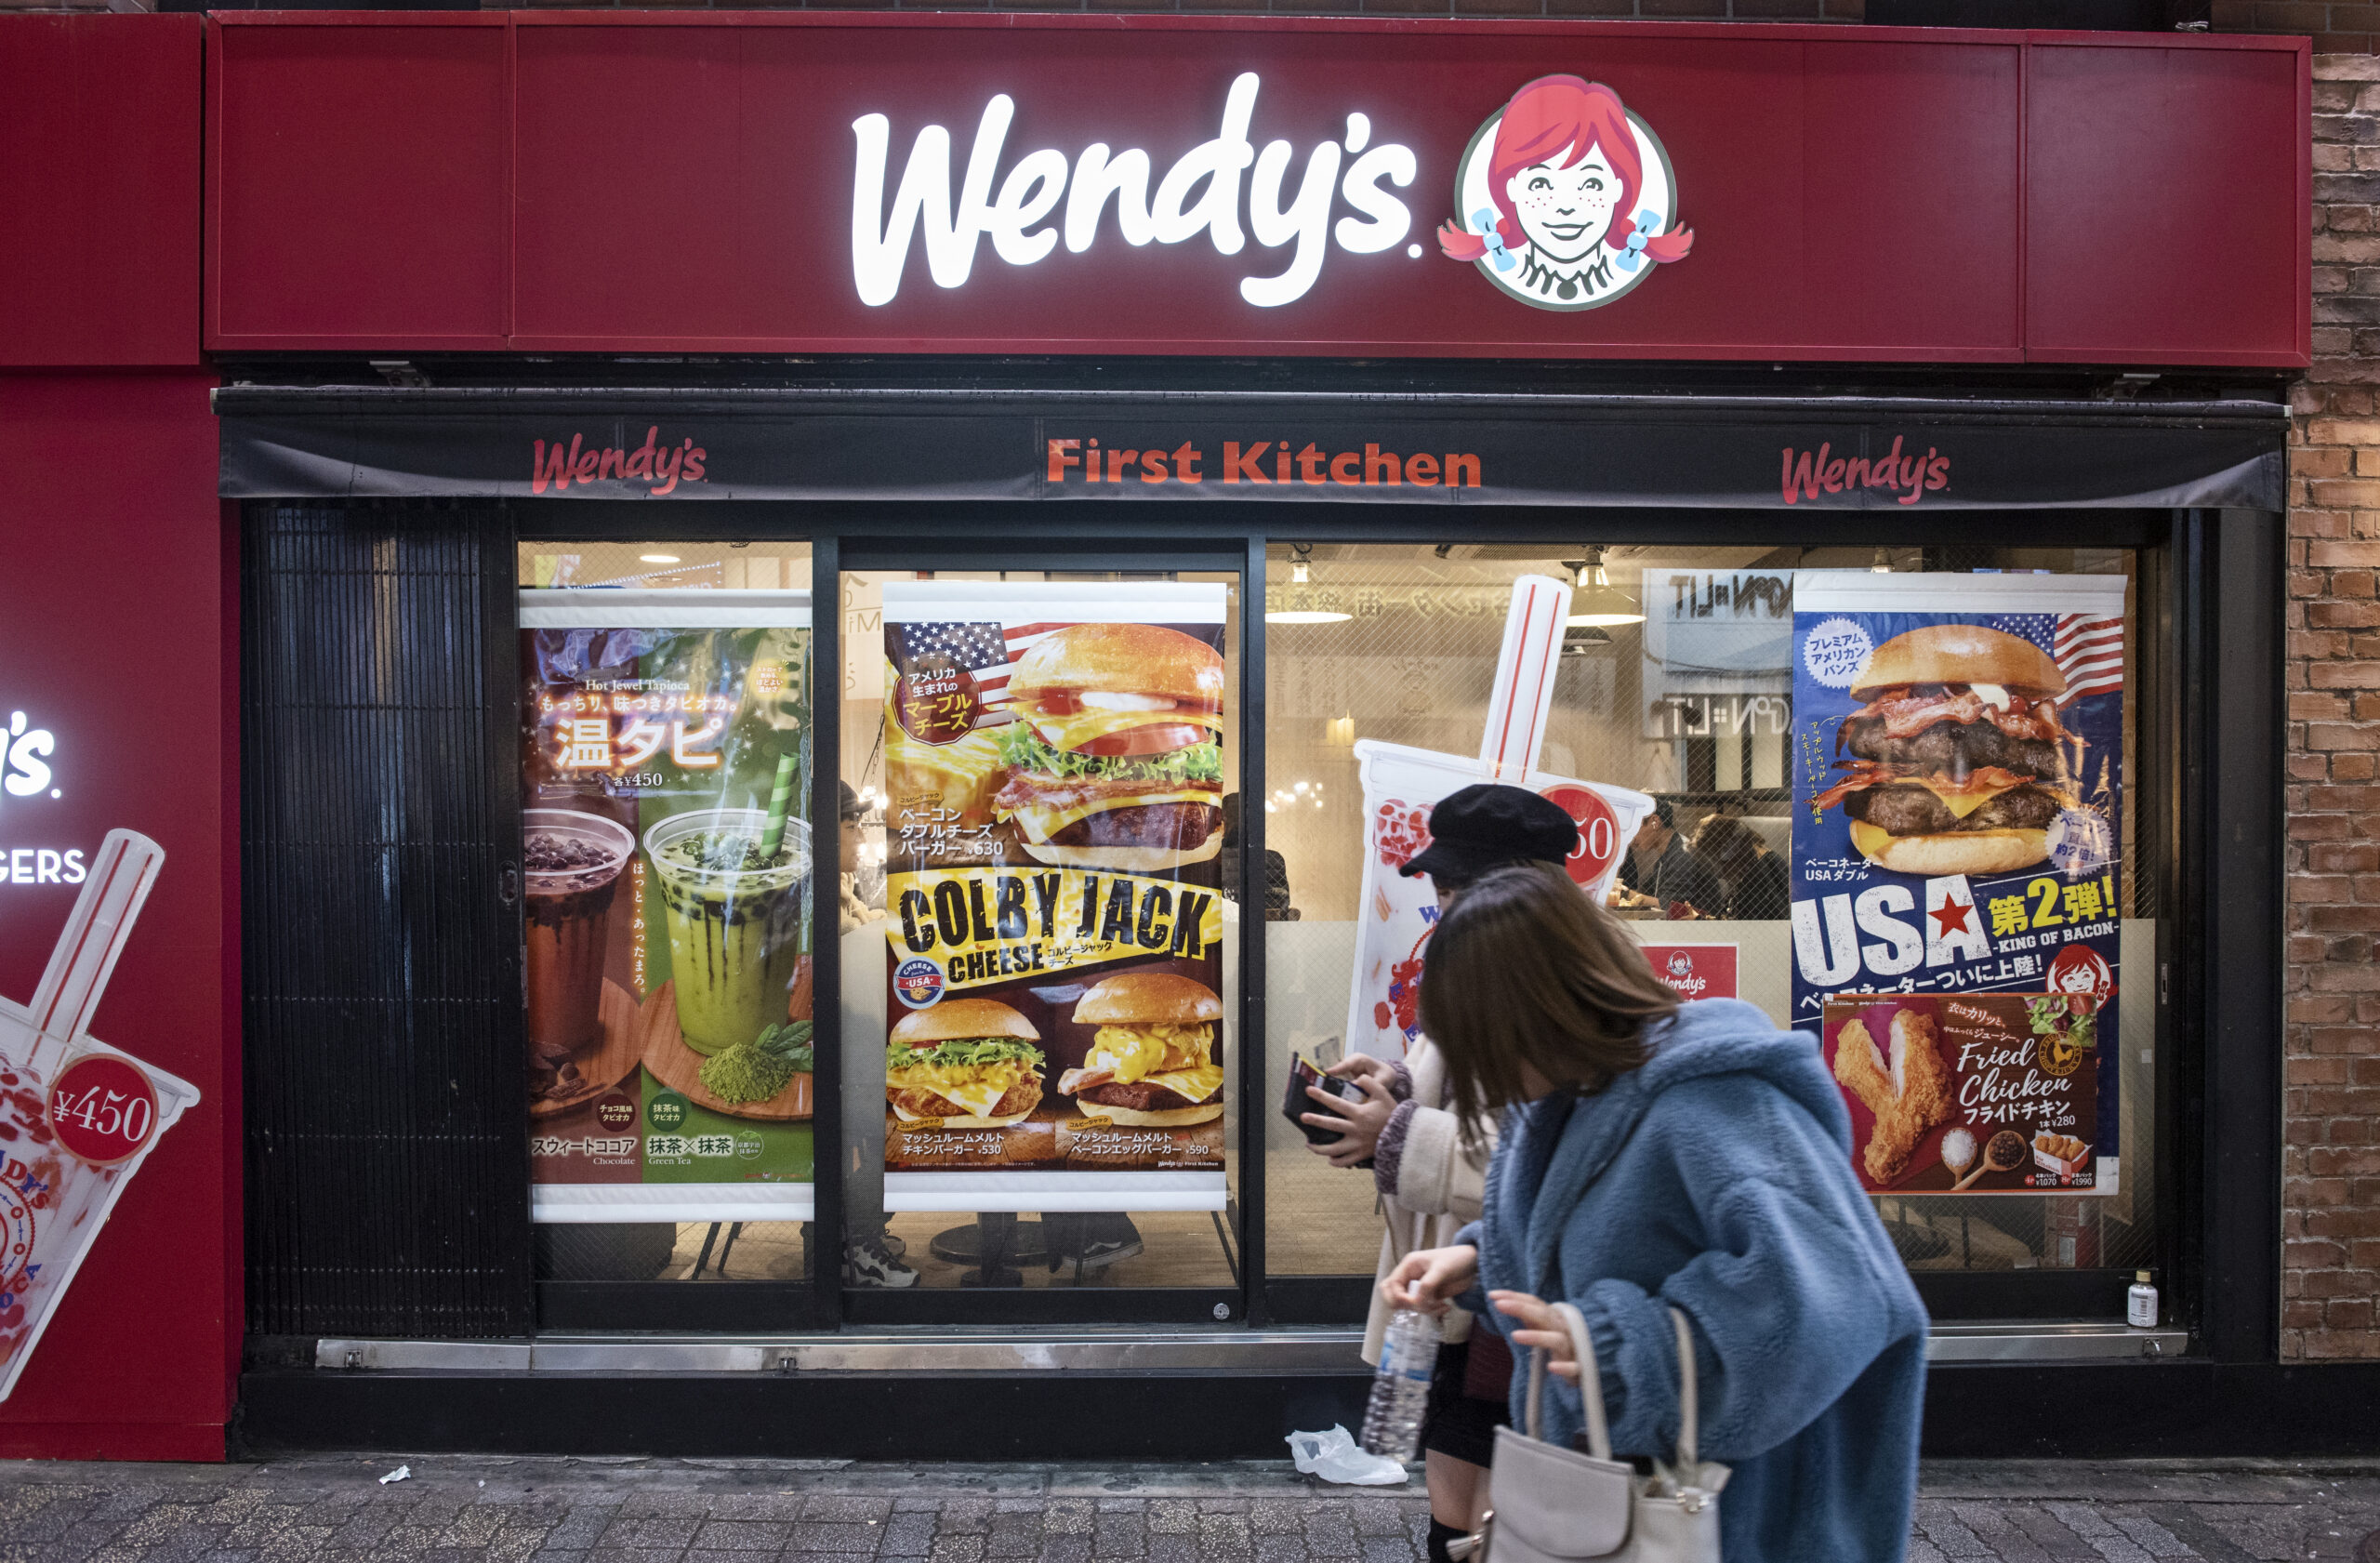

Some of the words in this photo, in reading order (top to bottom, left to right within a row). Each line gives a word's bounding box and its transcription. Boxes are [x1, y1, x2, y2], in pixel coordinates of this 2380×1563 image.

[1048, 438, 1202, 483] First
[1223, 441, 1481, 488] Kitchen
[1810, 633, 1863, 651] プレミアム
[1811, 648, 1866, 665] アメリカン
[908, 668, 956, 685] アメリカ
[1824, 661, 1859, 676] バンズ
[586, 680, 608, 691] Hot
[612, 680, 642, 692] Jewel
[647, 680, 690, 693] Tapioca
[912, 682, 958, 698] 生まれの
[903, 693, 972, 718] マーブル
[914, 710, 969, 736] チーズ
[556, 717, 723, 767] 温タピ
[899, 807, 961, 822] ベーコン
[899, 823, 994, 839] ダブルチーズ
[899, 841, 961, 855] バーガー
[968, 841, 1004, 855] ¥630
[1805, 857, 1883, 869] ベーコネーター
[1988, 875, 2117, 937] 第2弾!
[900, 874, 1061, 953] COLBY
[1077, 875, 1212, 960] JACK
[1792, 873, 1991, 987] USA
[2041, 932, 2058, 946] OF
[1048, 941, 1112, 958] コルビージャック
[903, 962, 932, 975] CHEESE
[947, 943, 1044, 984] CHEESE
[1049, 955, 1074, 967] チーズ
[908, 976, 931, 987] USA
[1949, 1002, 2006, 1027] 衣はカリッと、
[1957, 1038, 2036, 1072] Fried
[1959, 1067, 2072, 1106] Chicken
[53, 1086, 151, 1142] ¥450
[600, 1104, 632, 1113] チョコ風味
[653, 1104, 680, 1113] 抹茶味
[1964, 1100, 2070, 1125] フライドチキン
[2052, 1116, 2075, 1127] ¥280
[533, 1137, 635, 1155] スウィートココア
[903, 1133, 1005, 1143] マッシュルームメルト
[1071, 1133, 1172, 1143] マッシュルームメルト
[903, 1145, 974, 1155] チキンバーガー
[977, 1145, 1001, 1155] ¥530
[1071, 1144, 1182, 1155] ベーコンエッグバーガー
[1185, 1145, 1209, 1155] ¥590
[593, 1157, 635, 1166] Chocolate
[649, 1157, 674, 1166] Green
[677, 1157, 691, 1166] Tea
